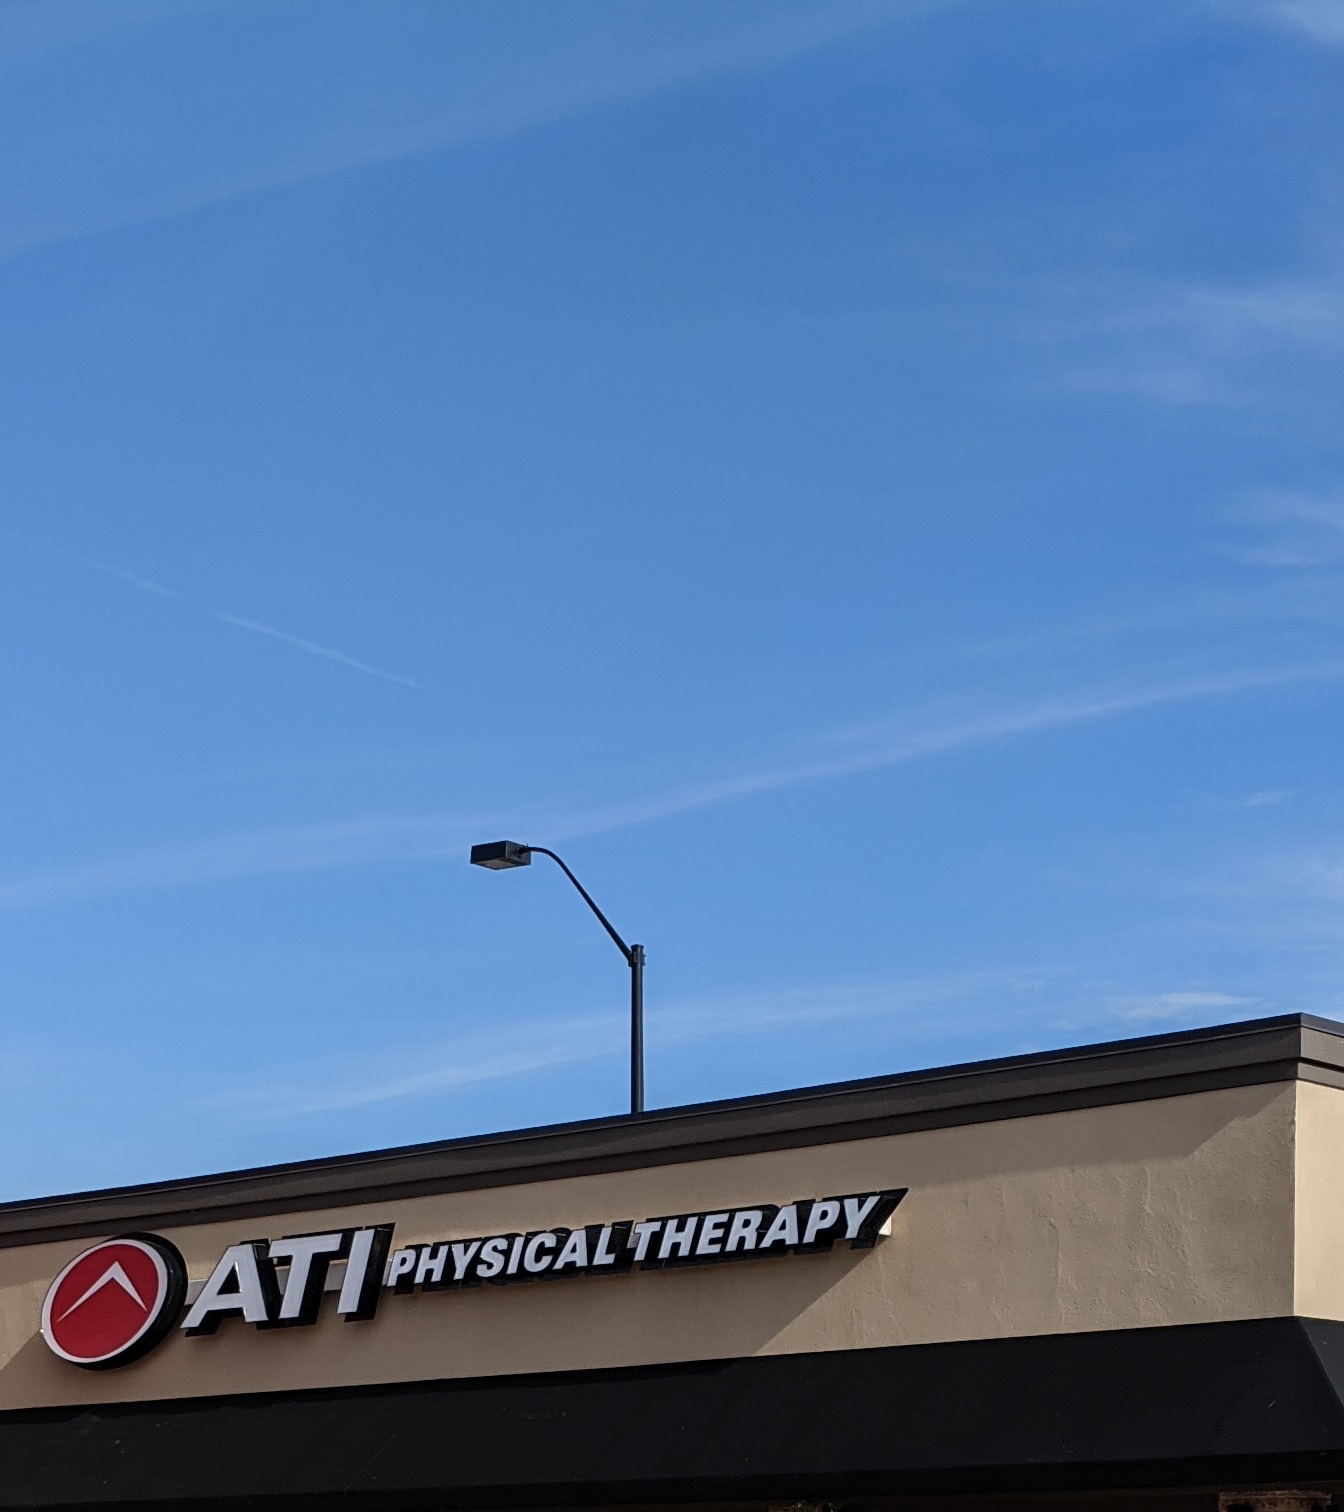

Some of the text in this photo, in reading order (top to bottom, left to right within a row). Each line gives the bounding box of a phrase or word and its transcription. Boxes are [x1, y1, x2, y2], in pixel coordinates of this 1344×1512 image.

[180, 1196, 881, 1329] ATI PHYSICAL THERAPY
